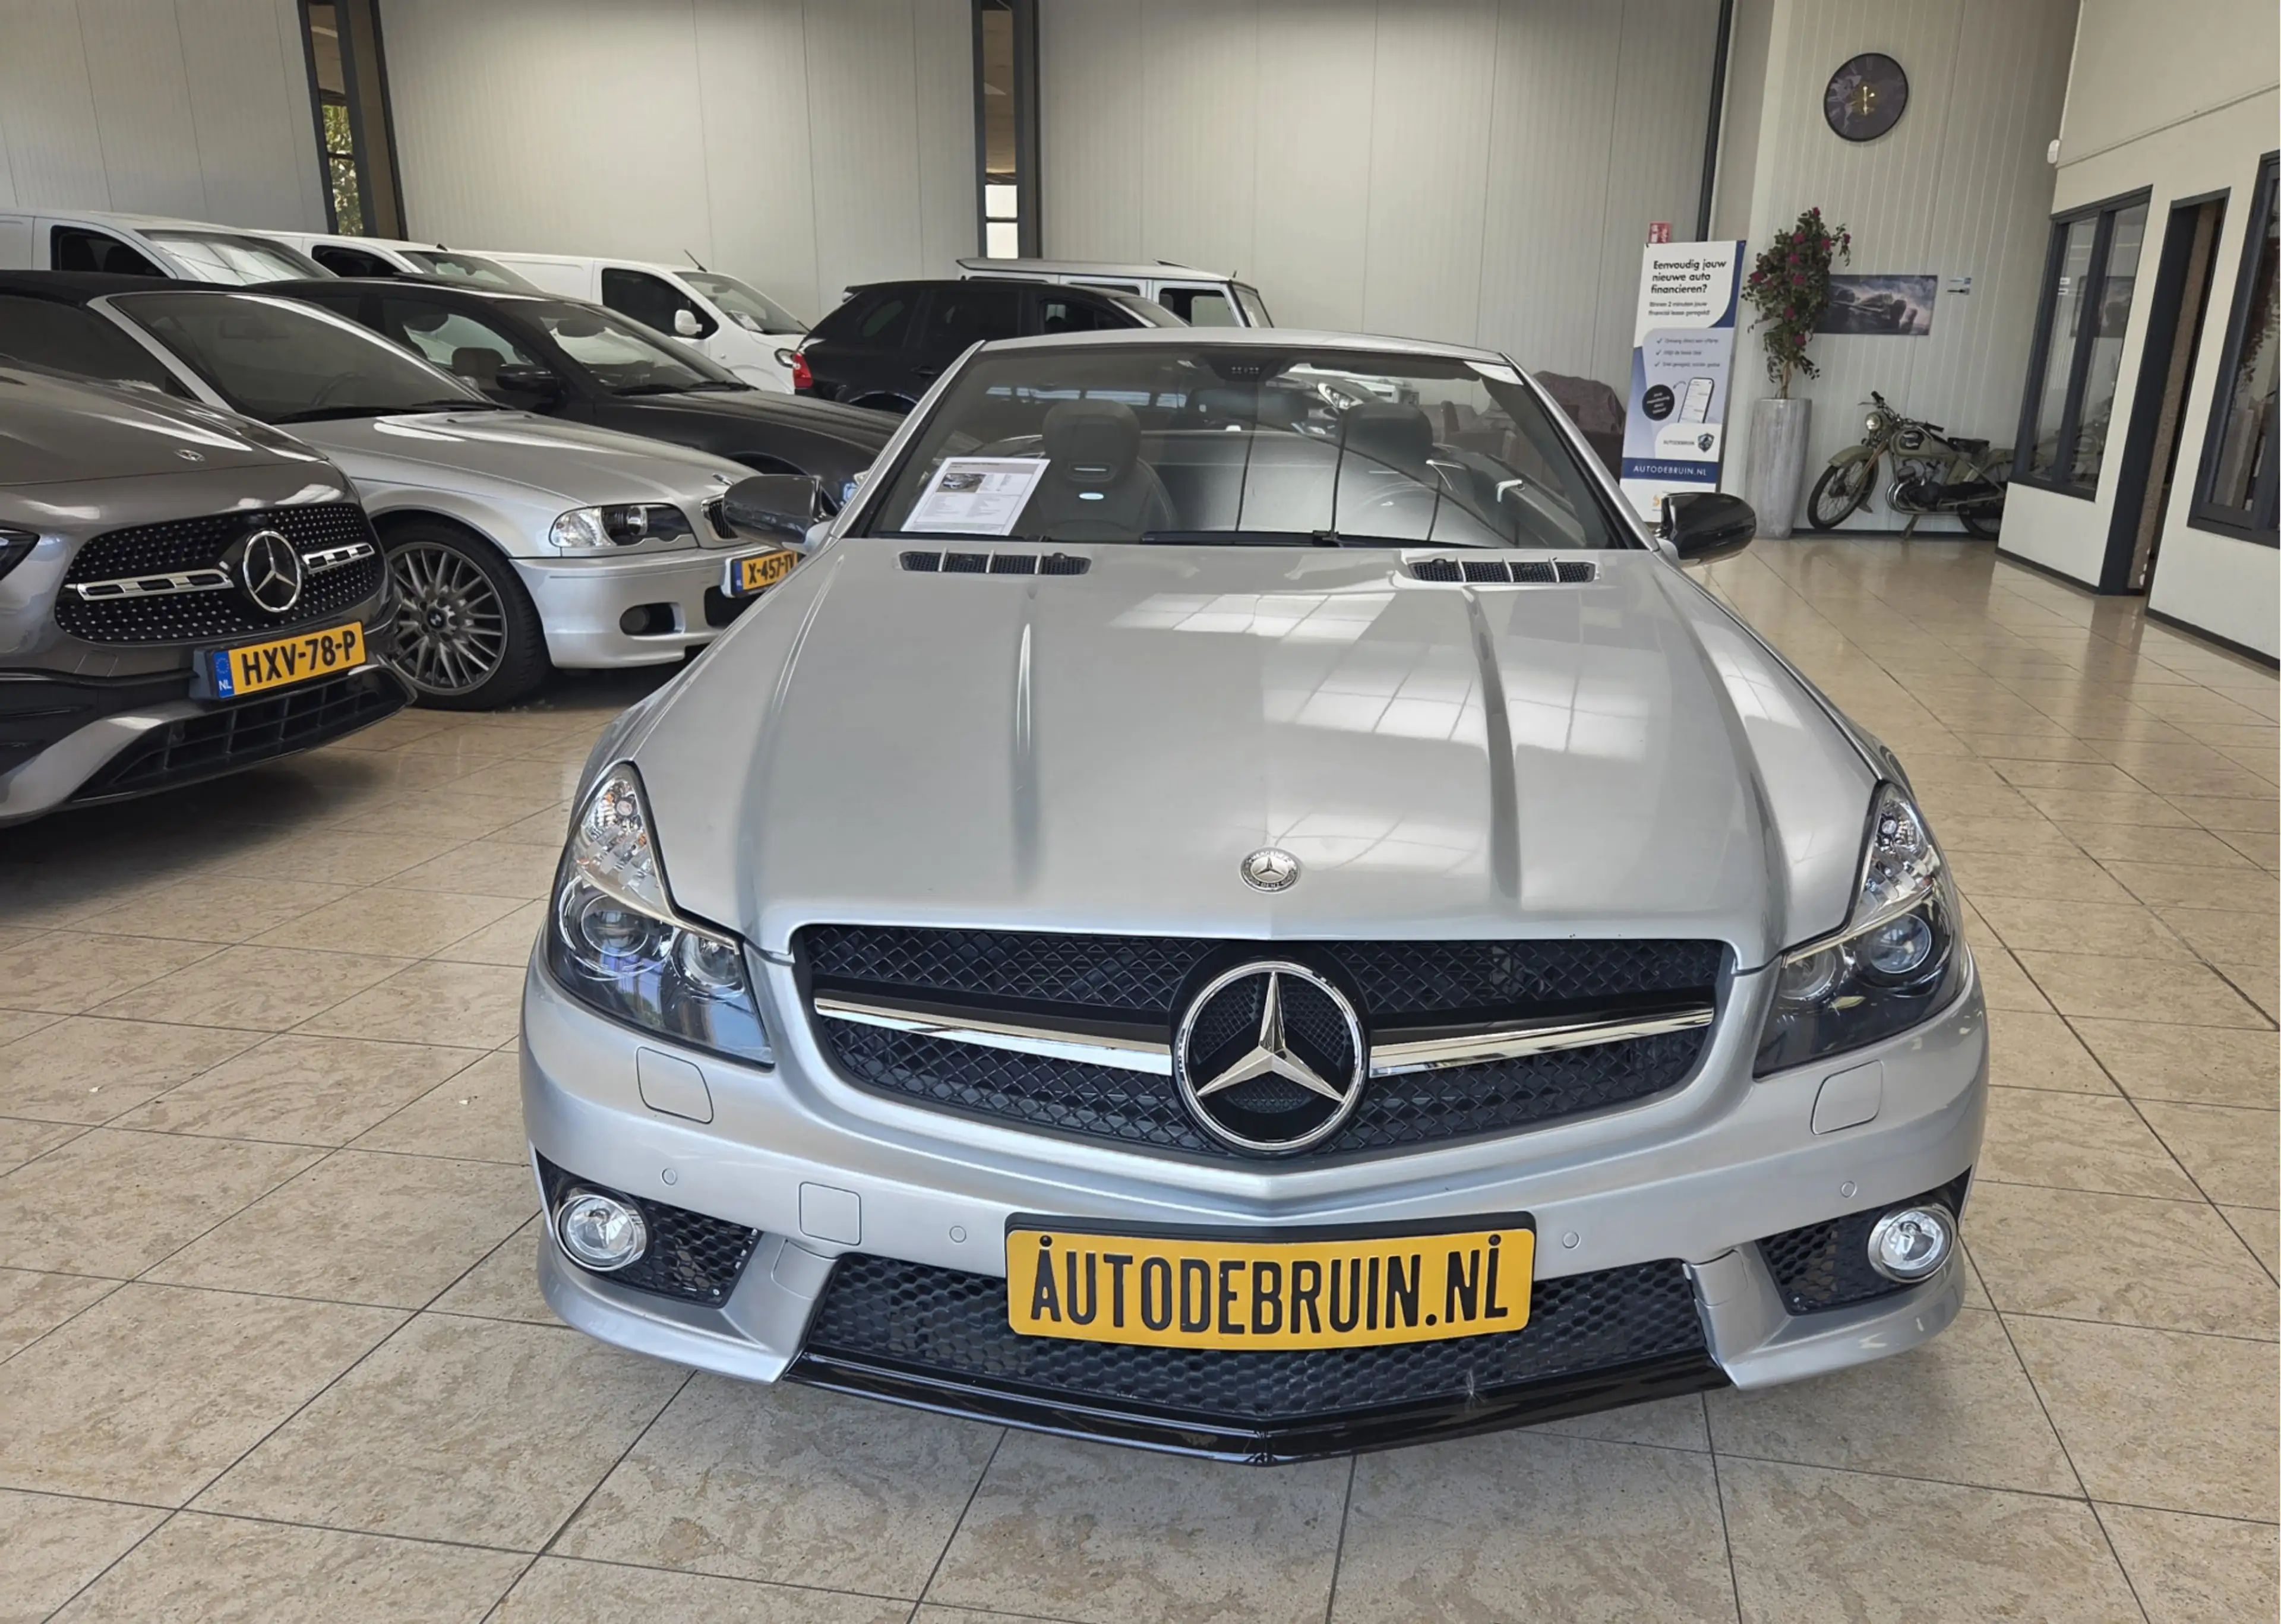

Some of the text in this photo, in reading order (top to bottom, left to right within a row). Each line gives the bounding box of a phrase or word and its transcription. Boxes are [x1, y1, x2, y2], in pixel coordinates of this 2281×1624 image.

[1653, 259, 1727, 271] Eenvoudig jouw
[1653, 272, 1711, 281] nieuwe auto
[1651, 284, 1707, 293] financieren?
[1633, 465, 1707, 476] AUTODEBRUIN.NL
[241, 630, 356, 685] HXV-78-P
[219, 679, 232, 691] NL
[1031, 1247, 1508, 1334] AUTODEBRUIN.NL
